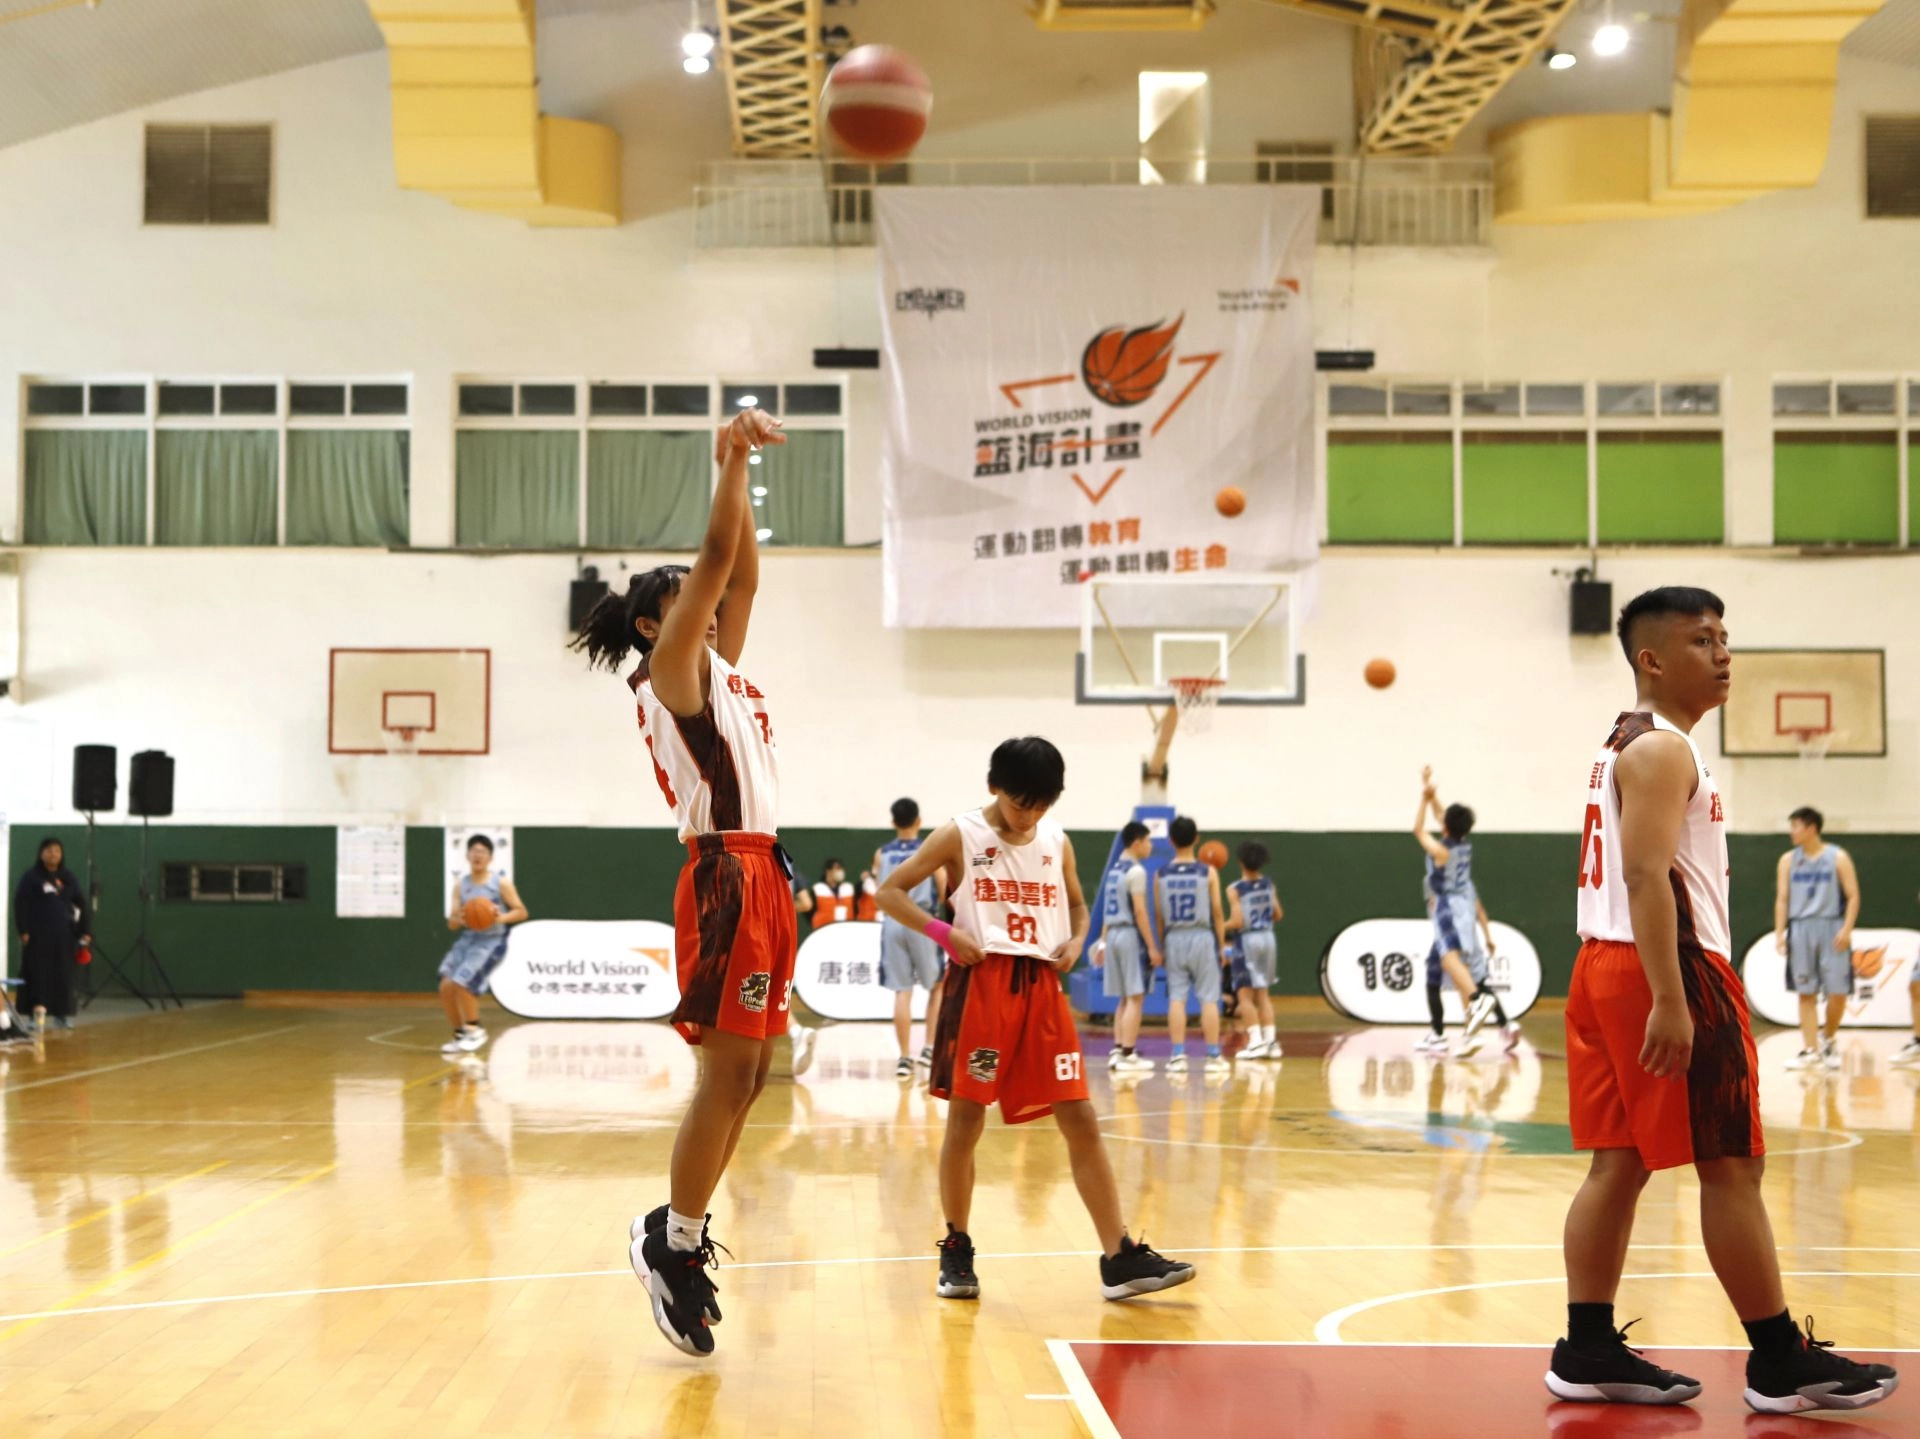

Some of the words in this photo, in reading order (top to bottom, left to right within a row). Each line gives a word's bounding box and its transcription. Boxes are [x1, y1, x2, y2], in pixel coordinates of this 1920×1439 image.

[975, 414, 1033, 433] WORLD
[1038, 408, 1091, 425] VISION
[974, 518, 1141, 560] 運動翻轉教育
[1169, 893, 1196, 922] 12
[527, 960, 585, 976] World
[591, 960, 649, 976] Vision
[818, 961, 882, 985] 唐德
[778, 979, 793, 1012] 3
